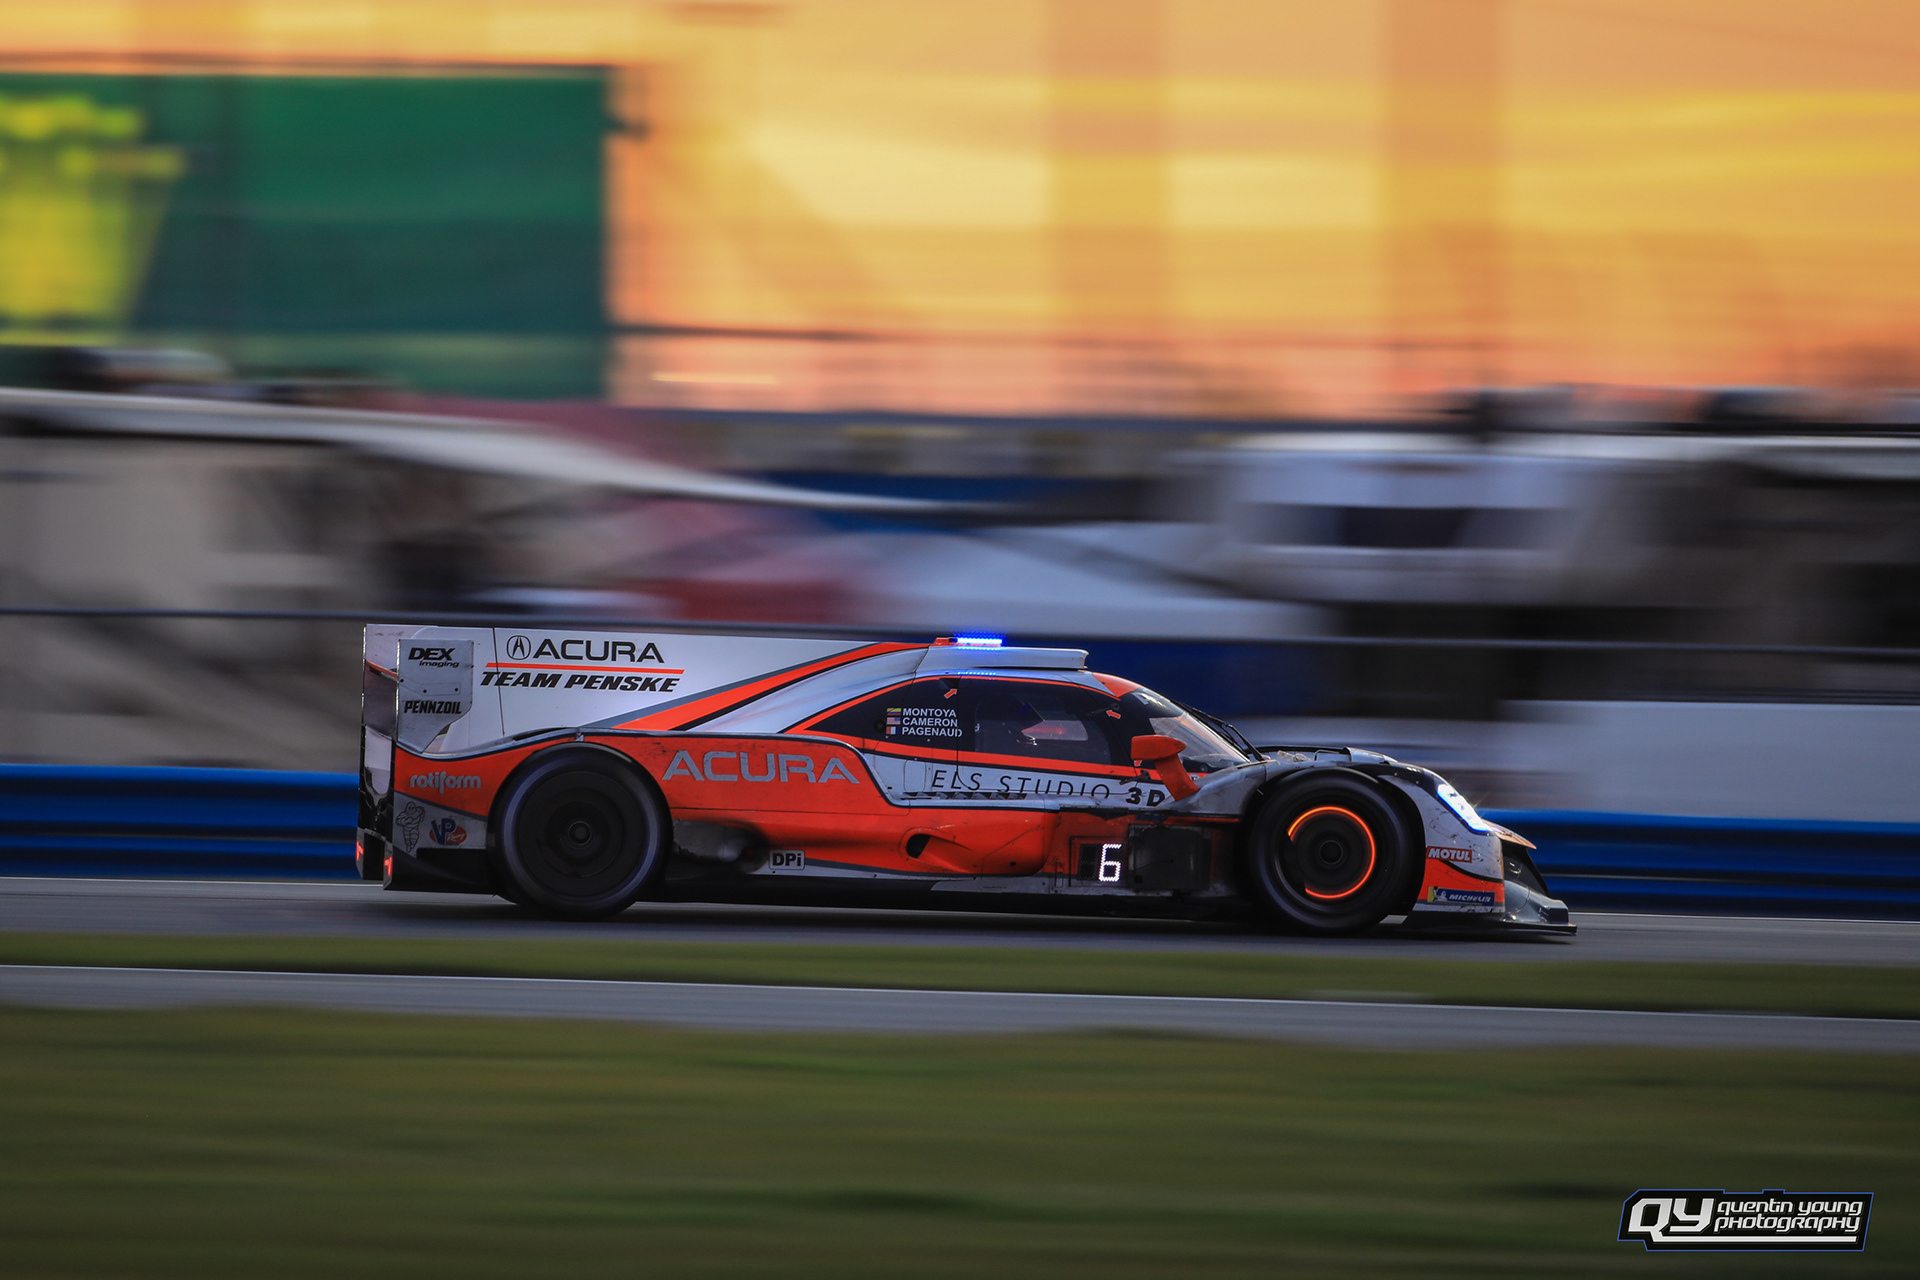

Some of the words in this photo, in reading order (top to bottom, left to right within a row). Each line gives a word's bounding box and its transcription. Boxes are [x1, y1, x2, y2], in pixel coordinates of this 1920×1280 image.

[408, 647, 456, 661] DEX
[532, 638, 665, 663] ACURA
[419, 660, 460, 669] imaging
[480, 671, 563, 688] TEAM
[564, 674, 680, 692] PENSKE
[404, 700, 462, 714] PENNZOIL
[902, 707, 957, 718] MONTOYA
[902, 717, 958, 727] CAMERON
[901, 726, 963, 738] PAGENAUD
[661, 750, 860, 784] ACURA
[409, 771, 482, 795] rotiform
[931, 769, 983, 791] ELS
[1125, 786, 1166, 807] 3D
[431, 818, 457, 845] VP
[772, 853, 802, 866] DPi
[1428, 848, 1471, 861] MOTUL
[1098, 843, 1122, 882] 6
[1449, 894, 1491, 903] MICHELIN
